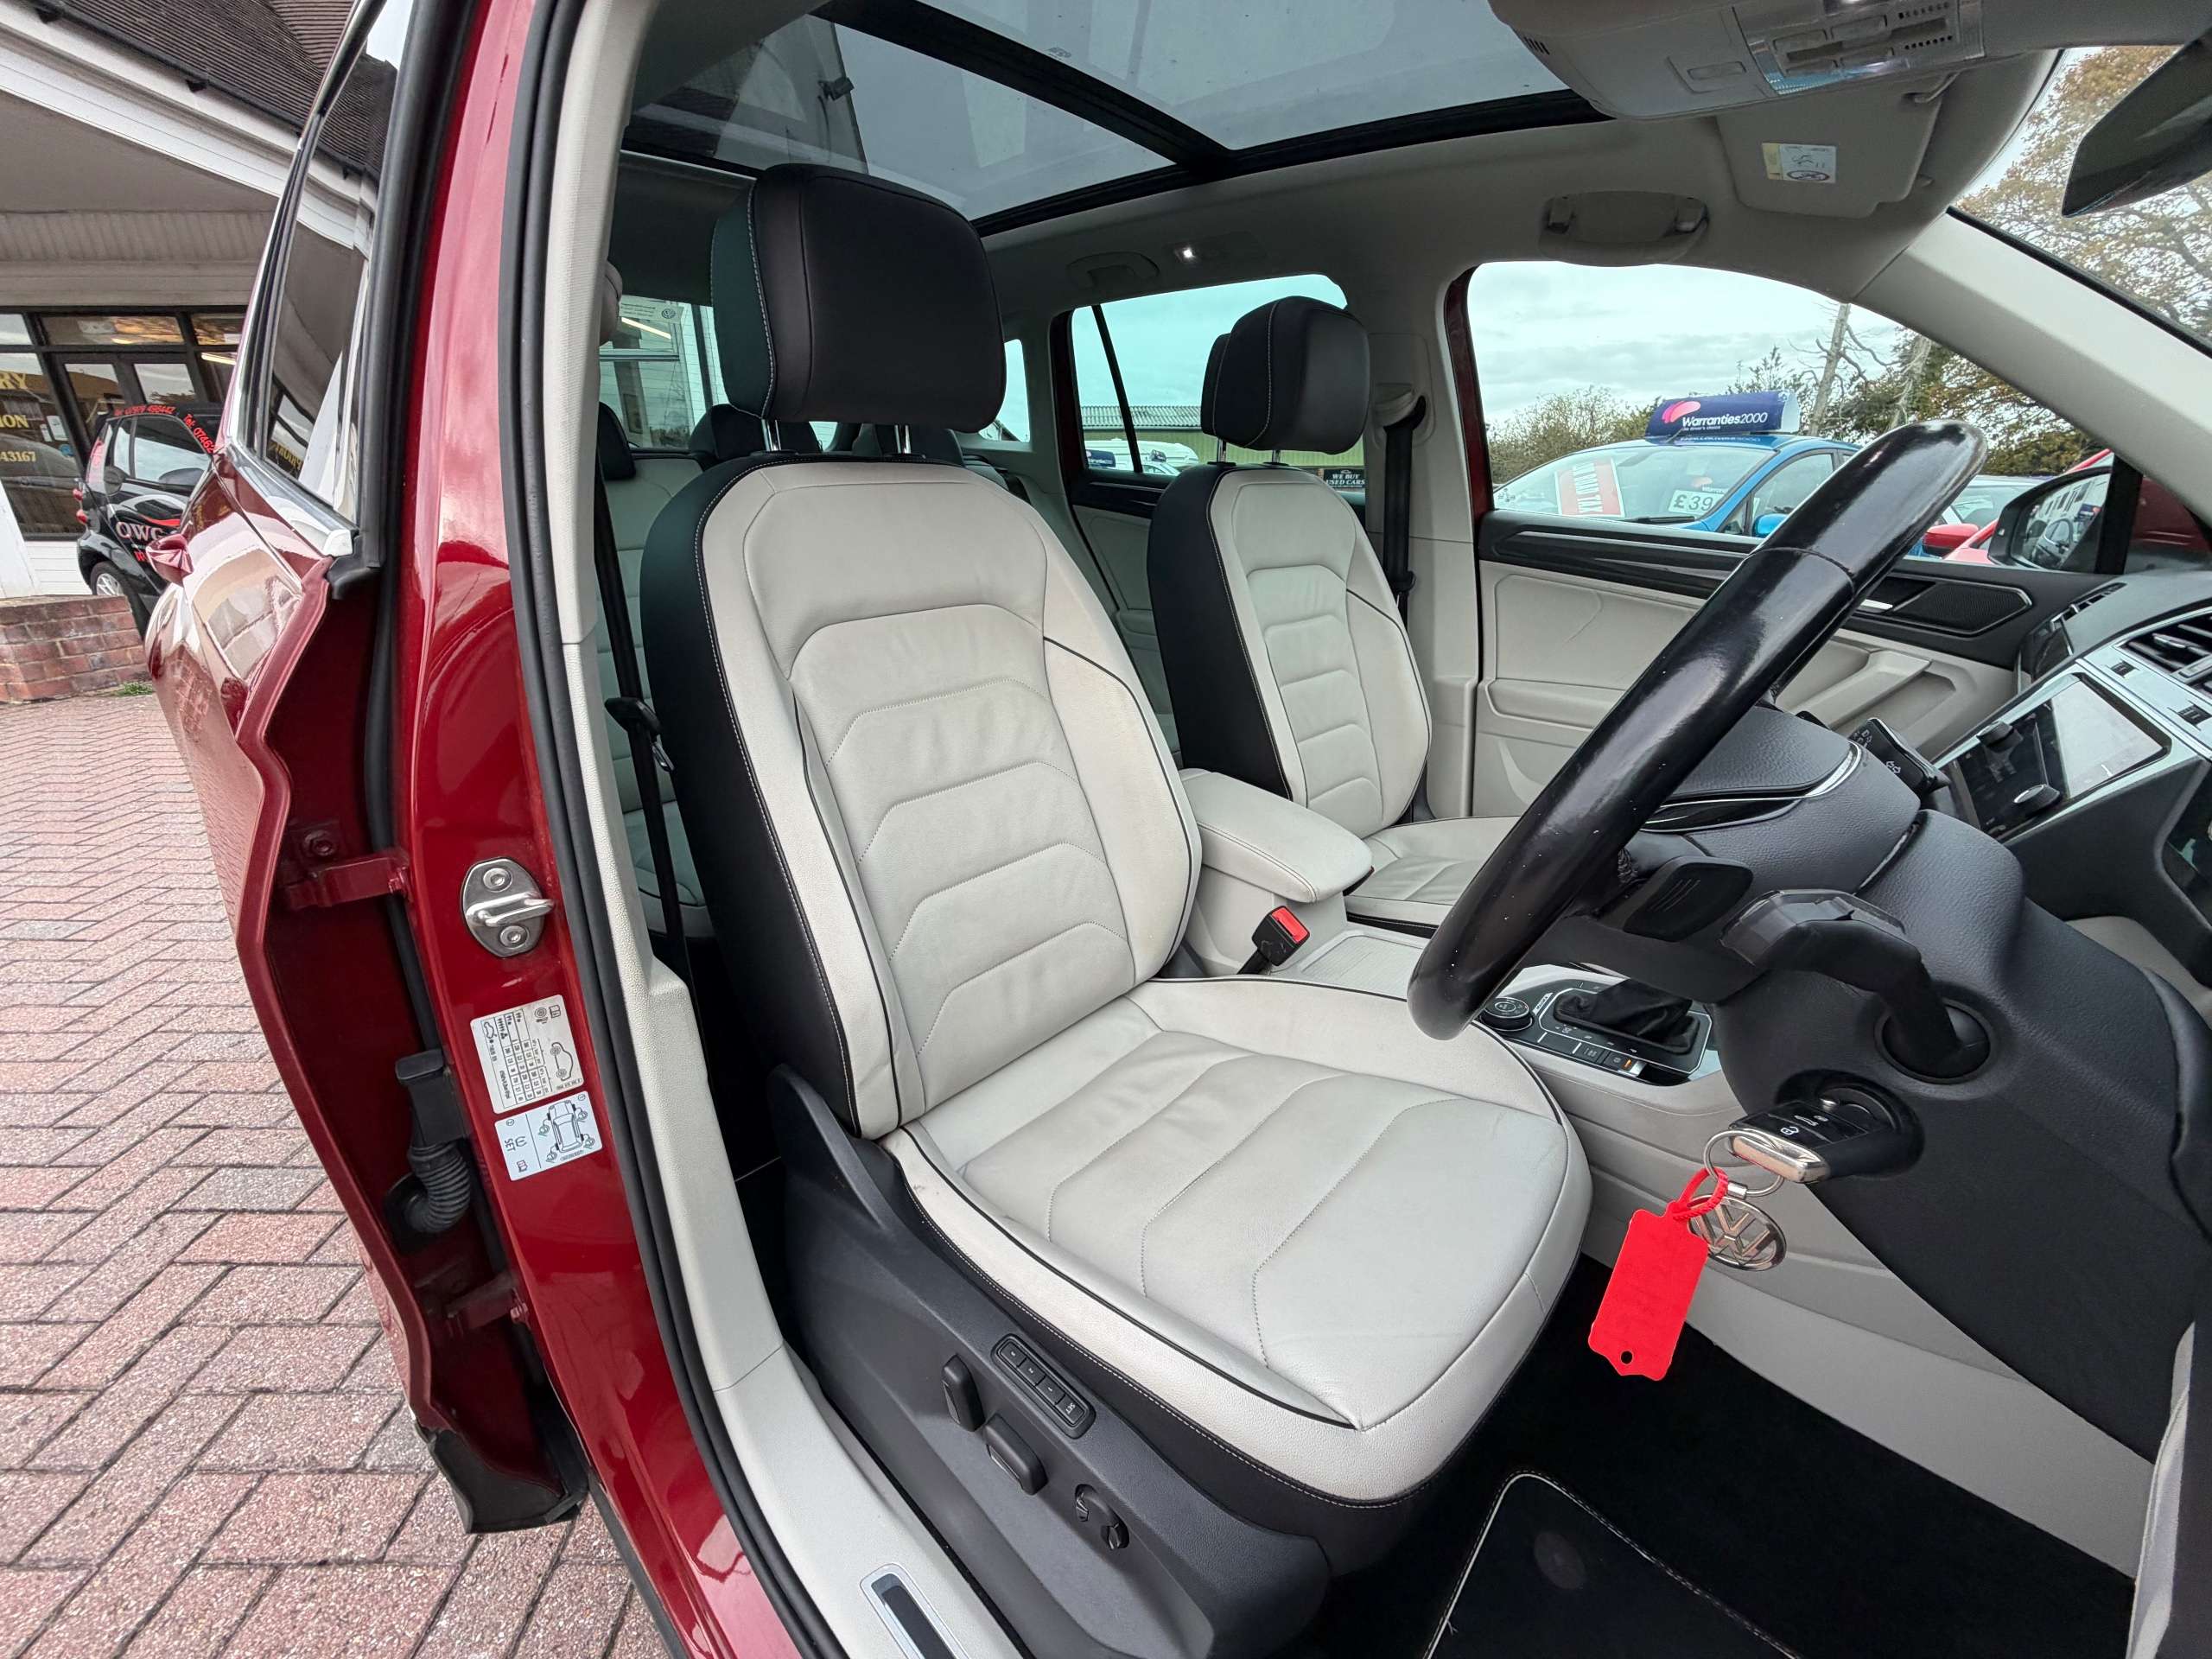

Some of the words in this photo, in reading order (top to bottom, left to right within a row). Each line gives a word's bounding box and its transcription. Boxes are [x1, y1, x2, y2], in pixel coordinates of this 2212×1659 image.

[1681, 412, 1768, 427] Warranties2000
[1577, 494, 1603, 513] TAX
[504, 1137, 516, 1152] SET
[1065, 1402, 1076, 1414] SET
